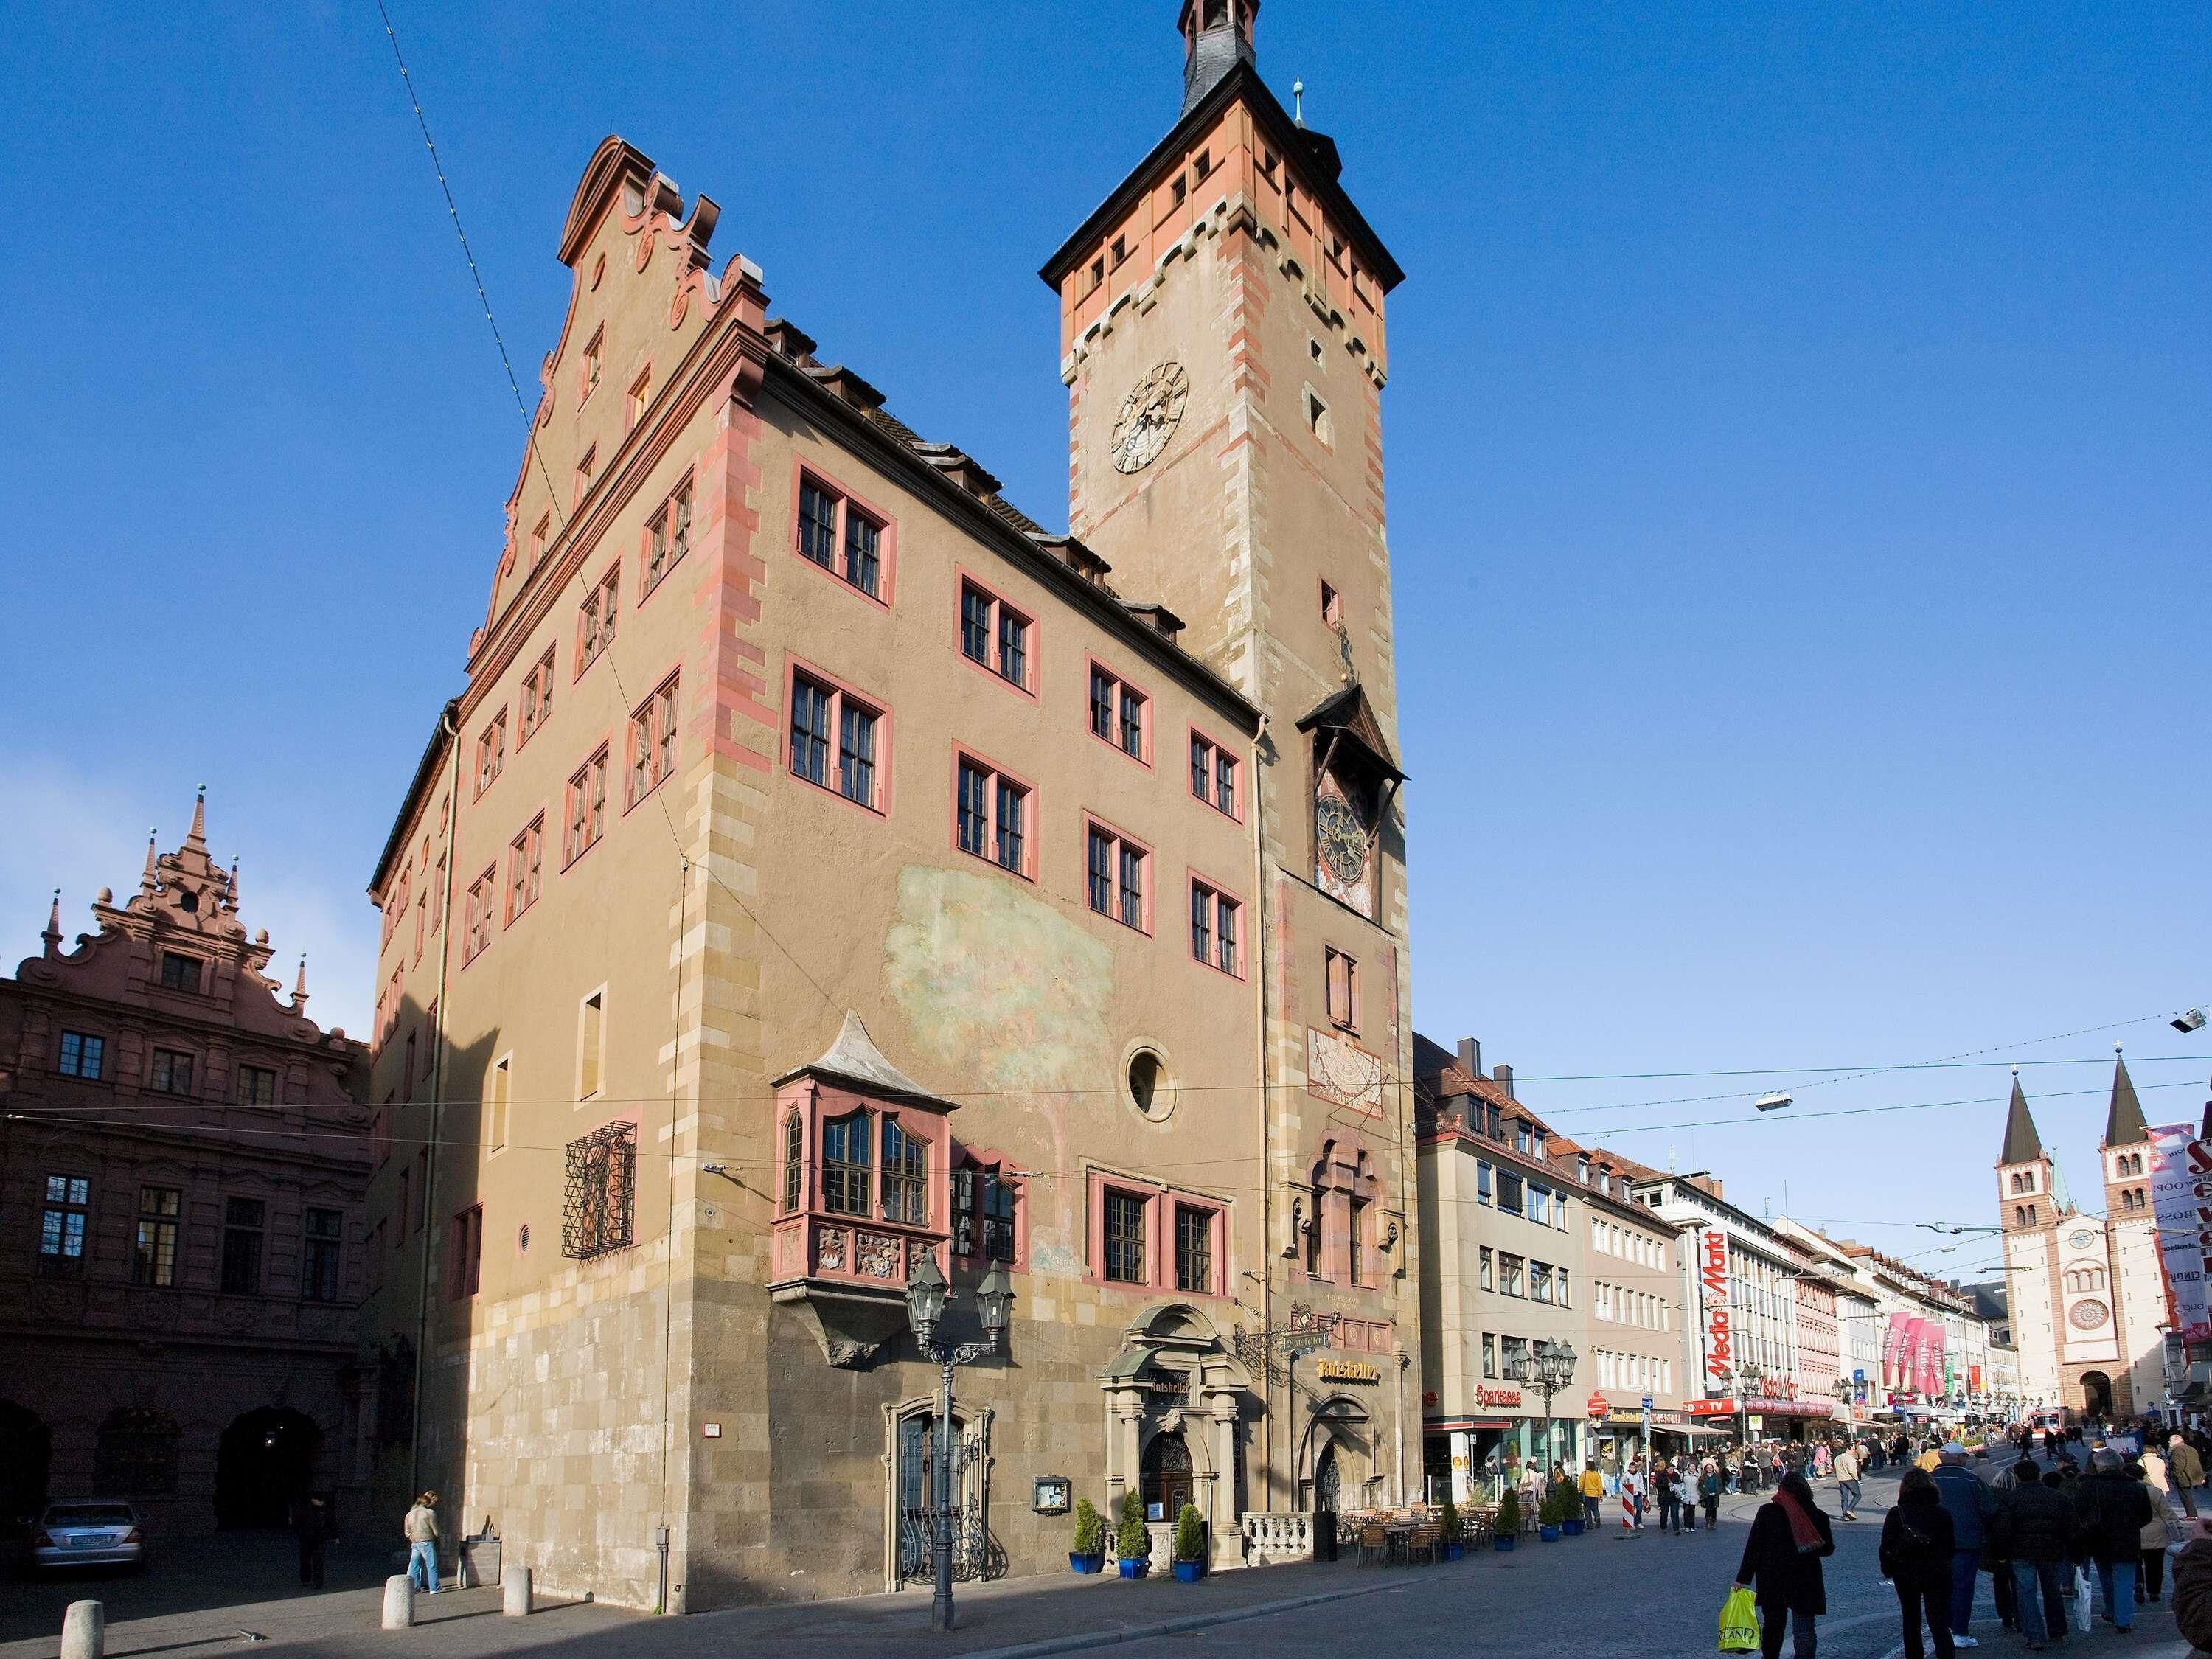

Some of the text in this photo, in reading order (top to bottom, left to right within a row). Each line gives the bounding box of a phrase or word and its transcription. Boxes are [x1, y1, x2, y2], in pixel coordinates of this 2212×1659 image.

[1703, 1231, 1727, 1296] Markt
[1476, 1385, 1521, 1407] Sparkasse
[1709, 1402, 1722, 1411] TV
